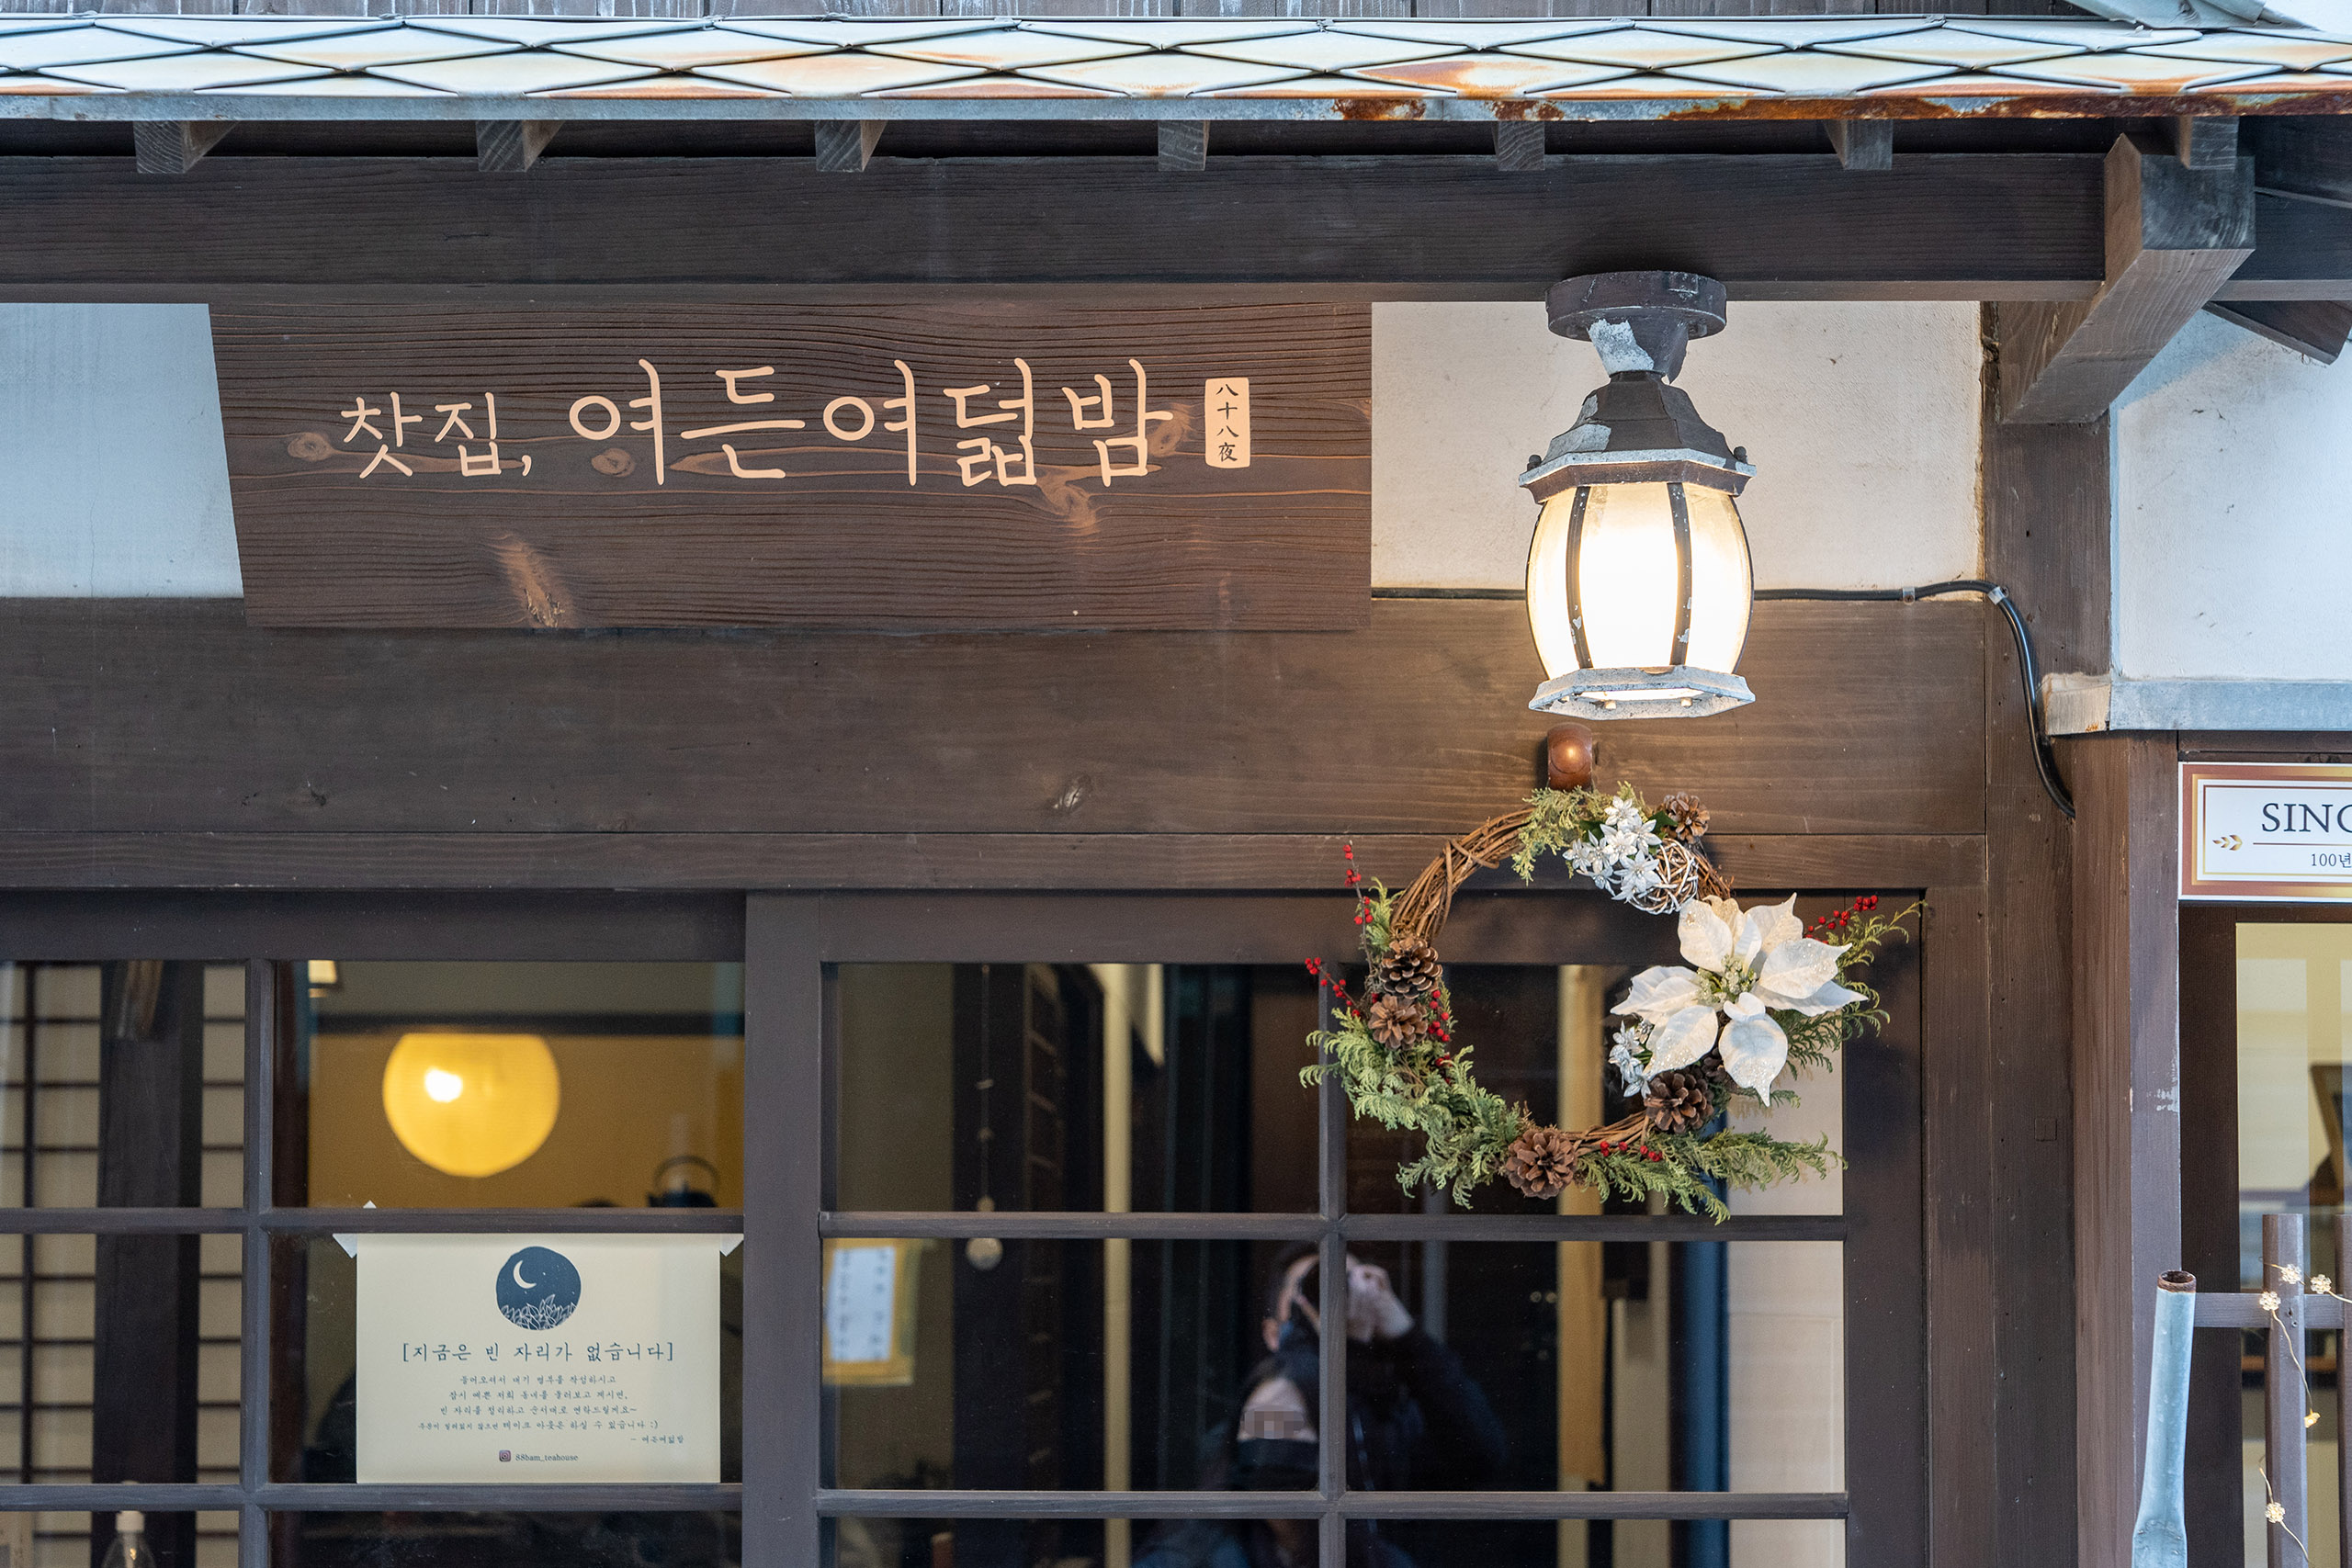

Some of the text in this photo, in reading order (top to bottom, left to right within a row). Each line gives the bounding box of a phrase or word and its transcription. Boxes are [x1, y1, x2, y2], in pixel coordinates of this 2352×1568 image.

[340, 357, 1175, 489] 찻집, 여든여덟밤
[1215, 383, 1239, 462] 八十八夜
[401, 1341, 674, 1363] [지금은 빈 자리가 없습니다]
[512, 1374, 530, 1385] 대기
[537, 1374, 565, 1385] 명부를
[569, 1374, 616, 1385] 작성하시고
[448, 1390, 467, 1401] 잠시
[472, 1390, 492, 1401] 예쁜
[497, 1390, 514, 1401] 저희
[520, 1390, 548, 1401] 동네를
[554, 1390, 592, 1401] 둘러보고
[440, 1404, 448, 1416] 빈
[453, 1404, 482, 1416] 자리를
[487, 1404, 525, 1416] 정리하고
[529, 1404, 569, 1416] 순서대로
[503, 1419, 532, 1430] 테이크
[536, 1419, 565, 1431] 아웃은
[570, 1419, 588, 1430] 하실
[594, 1420, 603, 1430] 수
[608, 1419, 646, 1430] 있습니다
[514, 1453, 579, 1462] 88bam_teahouse
